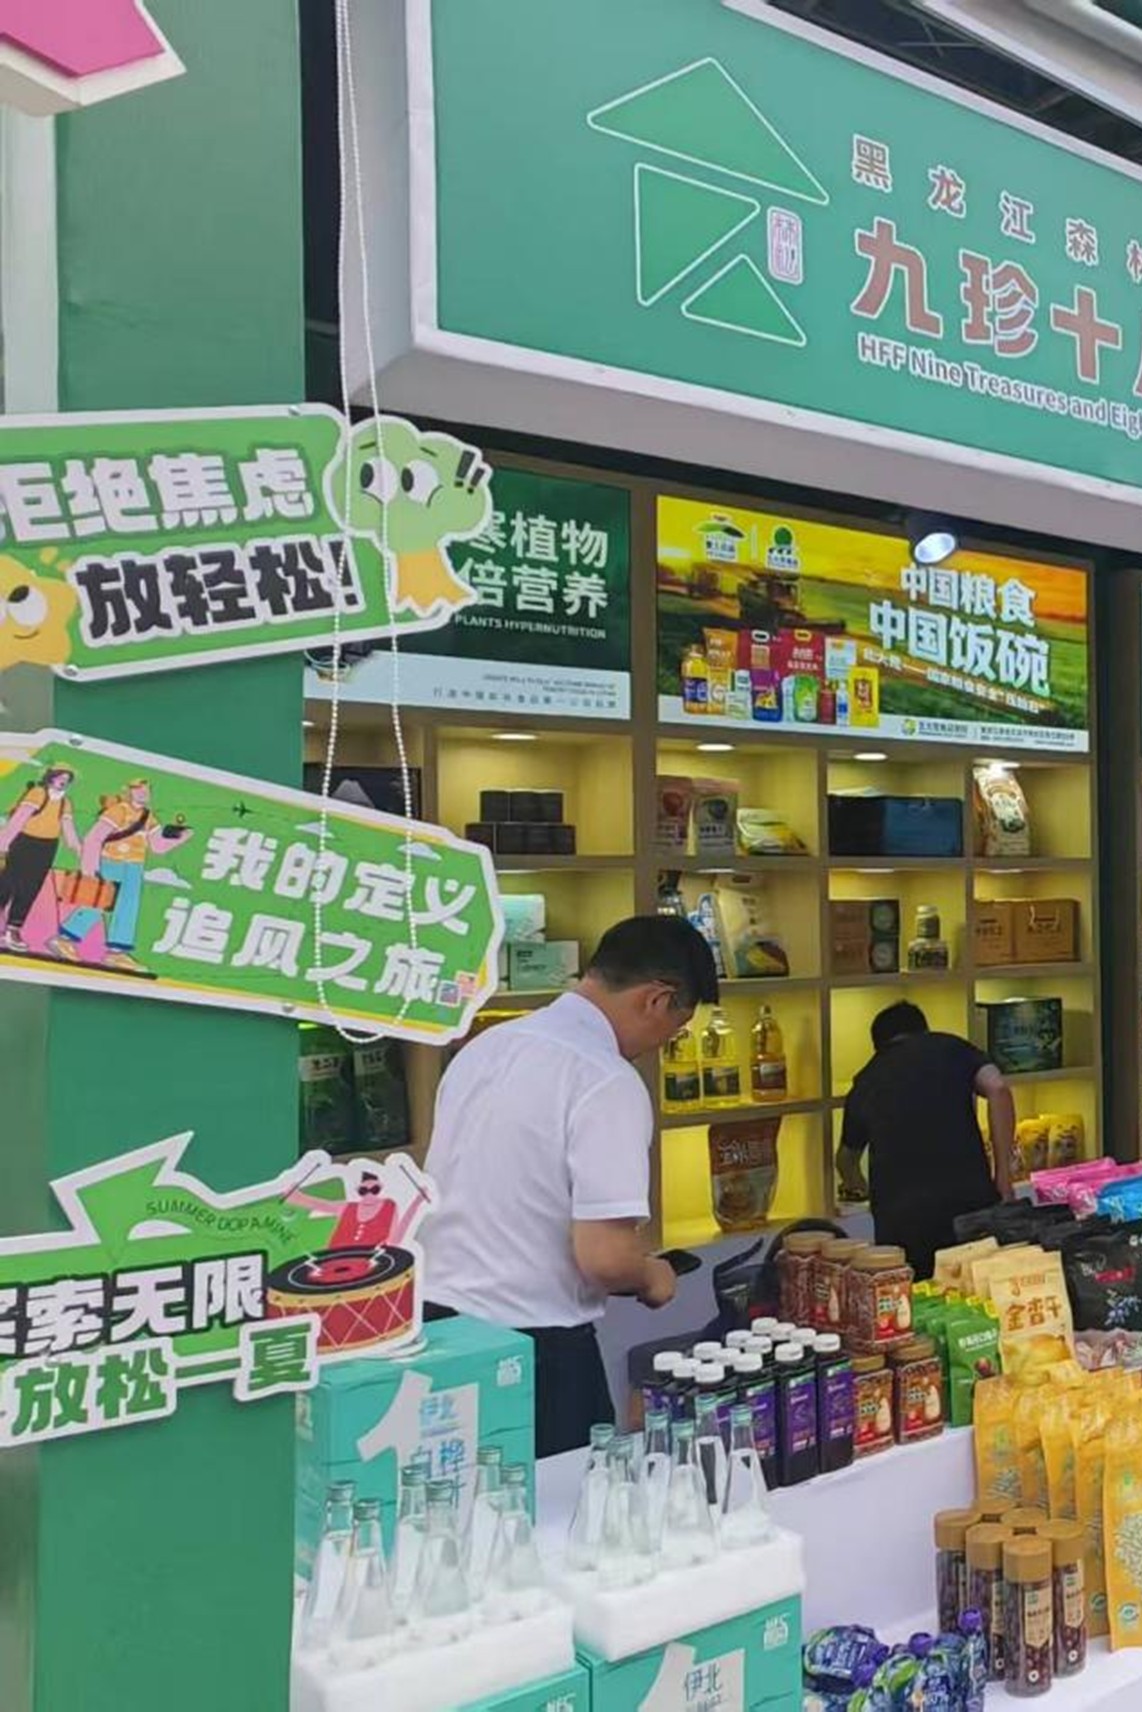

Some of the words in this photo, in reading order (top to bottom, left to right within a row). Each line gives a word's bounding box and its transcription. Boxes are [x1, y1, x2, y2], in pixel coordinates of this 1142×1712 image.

[858, 333, 907, 368] HFF
[908, 342, 964, 386] Nine
[966, 361, 1068, 415] Treasures
[1070, 383, 1107, 421] and
[0, 448, 316, 541] 拒绝焦虑
[900, 562, 1036, 628] 中国粮食
[869, 600, 1051, 698] 中国饭碗
[201, 826, 477, 936] 我的定义
[152, 898, 446, 1004] 追风之旅
[145, 1199, 217, 1228] SUMMER
[12, 1324, 313, 1437] 放松一夏
